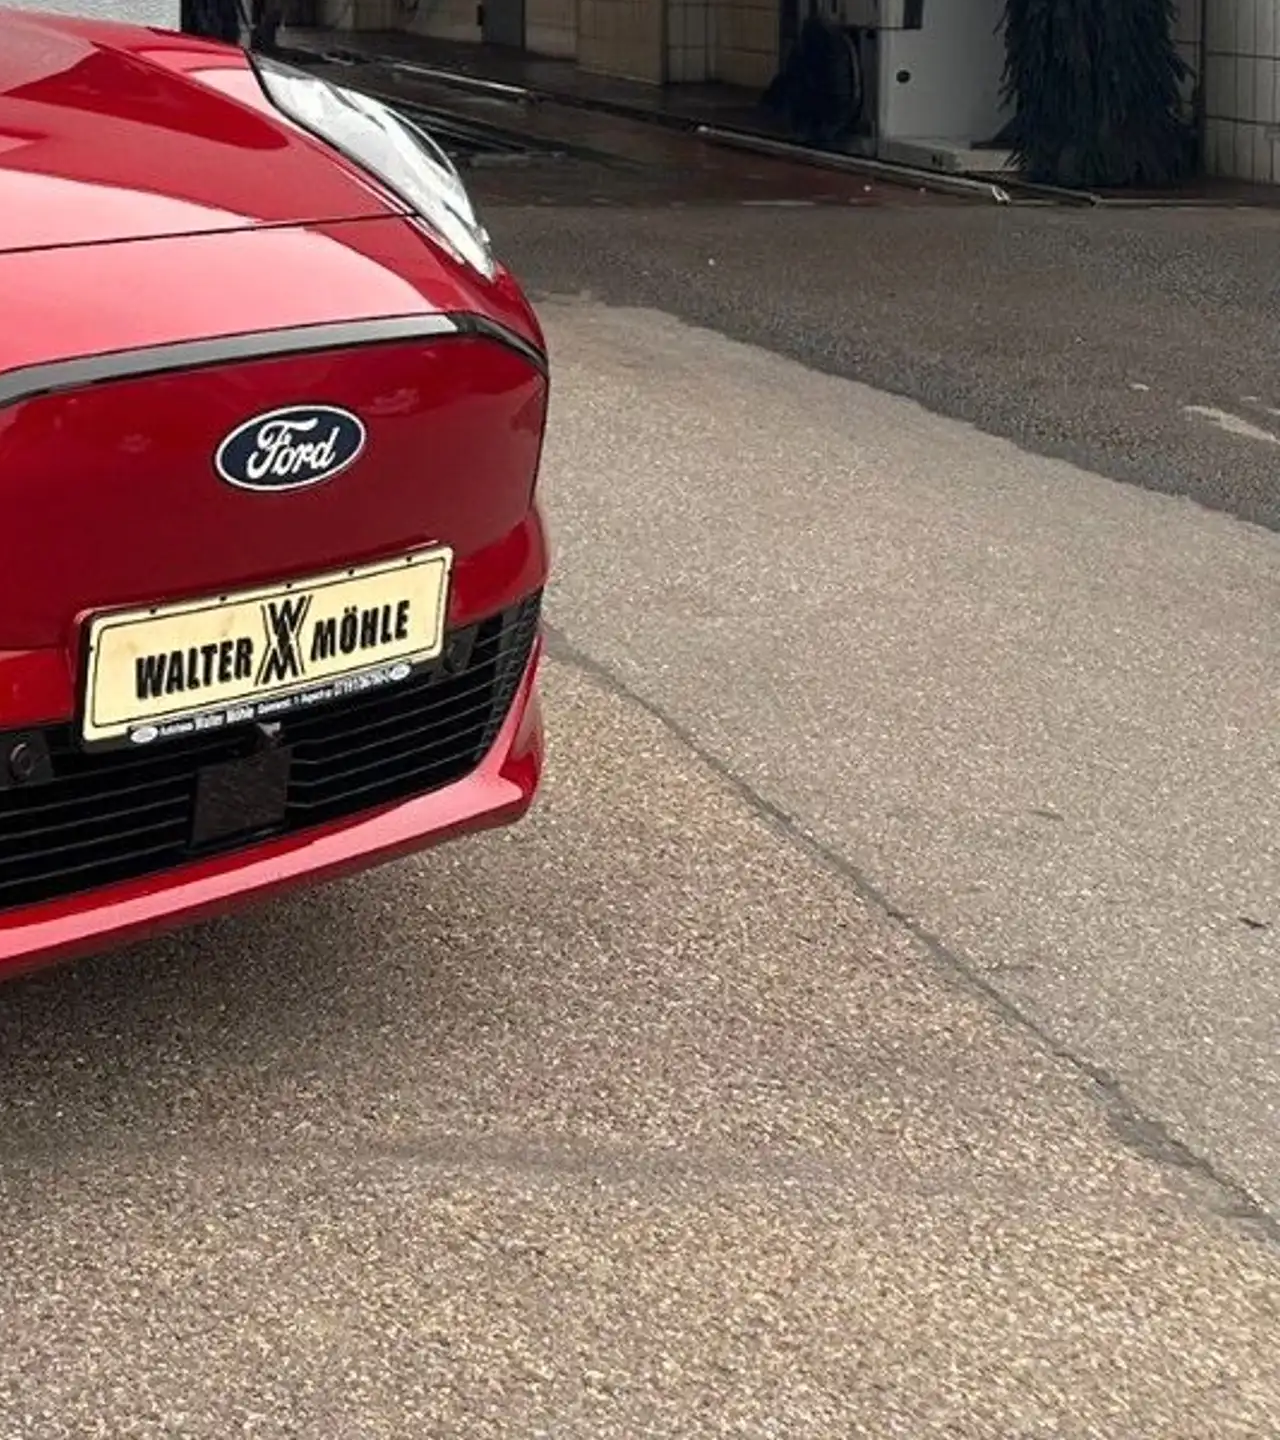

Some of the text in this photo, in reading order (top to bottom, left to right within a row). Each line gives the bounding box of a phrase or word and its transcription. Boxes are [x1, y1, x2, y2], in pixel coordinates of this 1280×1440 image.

[247, 417, 340, 479] Ford
[135, 636, 254, 699] WALTER
[309, 599, 410, 663] MÖHLE
